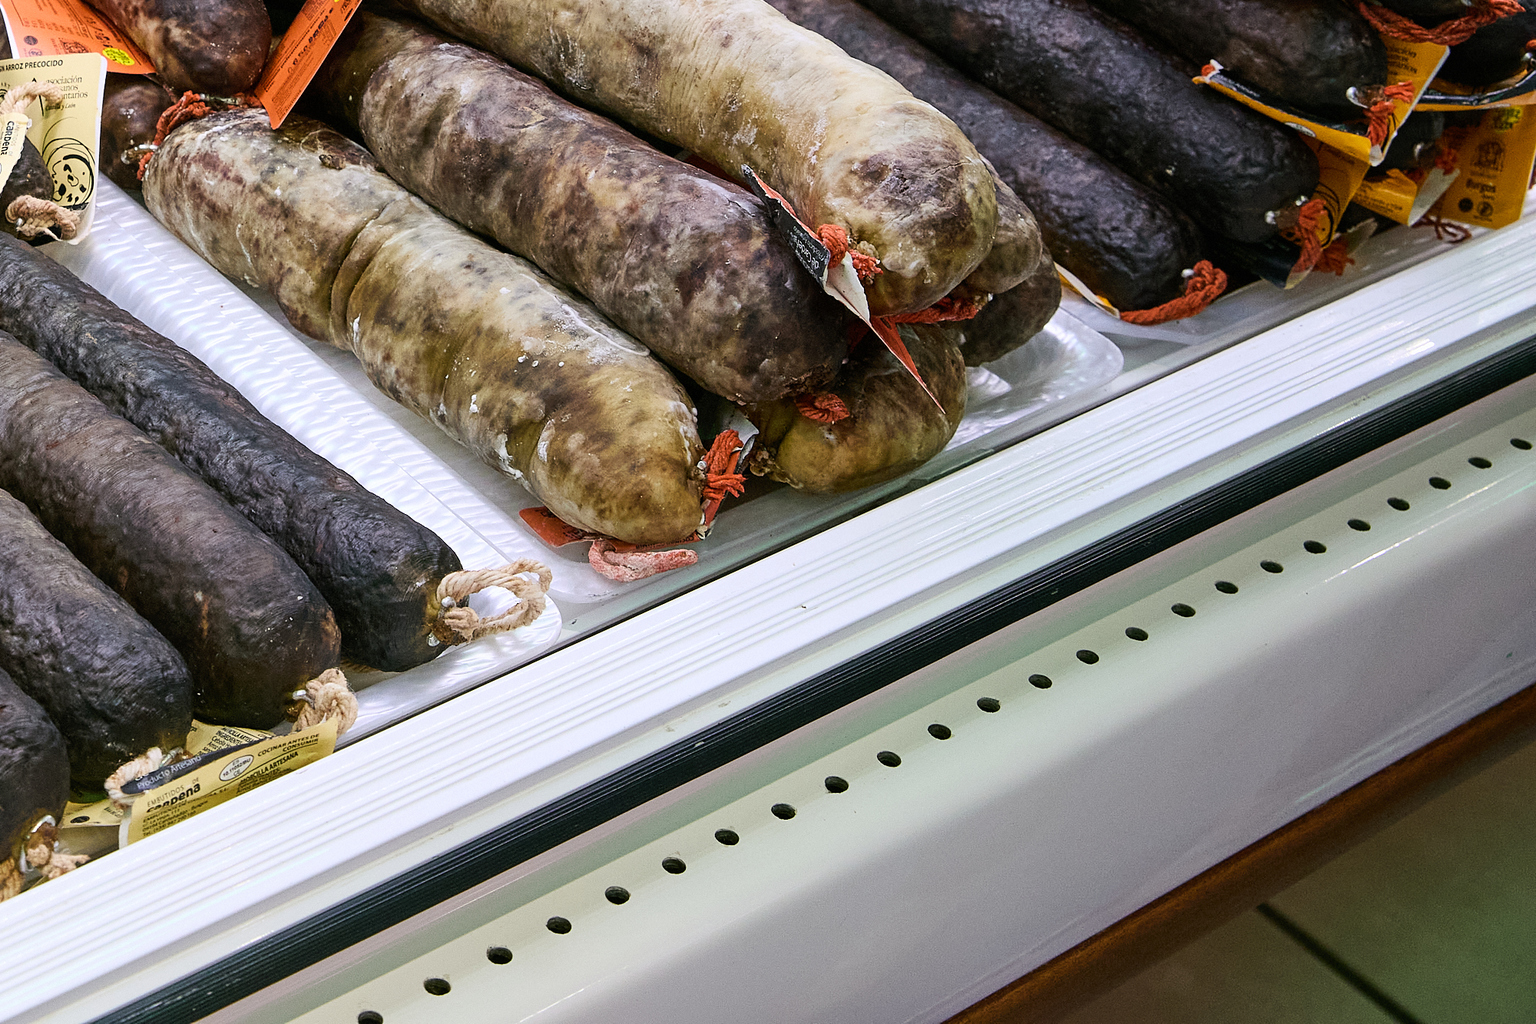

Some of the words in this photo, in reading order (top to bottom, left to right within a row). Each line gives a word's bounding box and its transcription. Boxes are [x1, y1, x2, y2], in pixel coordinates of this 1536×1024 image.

[5, 63, 24, 72] ARROZ
[24, 59, 64, 69] PRECOCIDO
[257, 743, 287, 757] COCINAR
[287, 736, 310, 747] ANTES
[282, 739, 318, 752] CONSUMIR
[270, 752, 299, 770] ARTESANA
[137, 772, 170, 790] Producto
[170, 756, 202, 774] Artesano
[147, 785, 185, 808] EMBUTIDOS
[192, 776, 200, 785] DE
